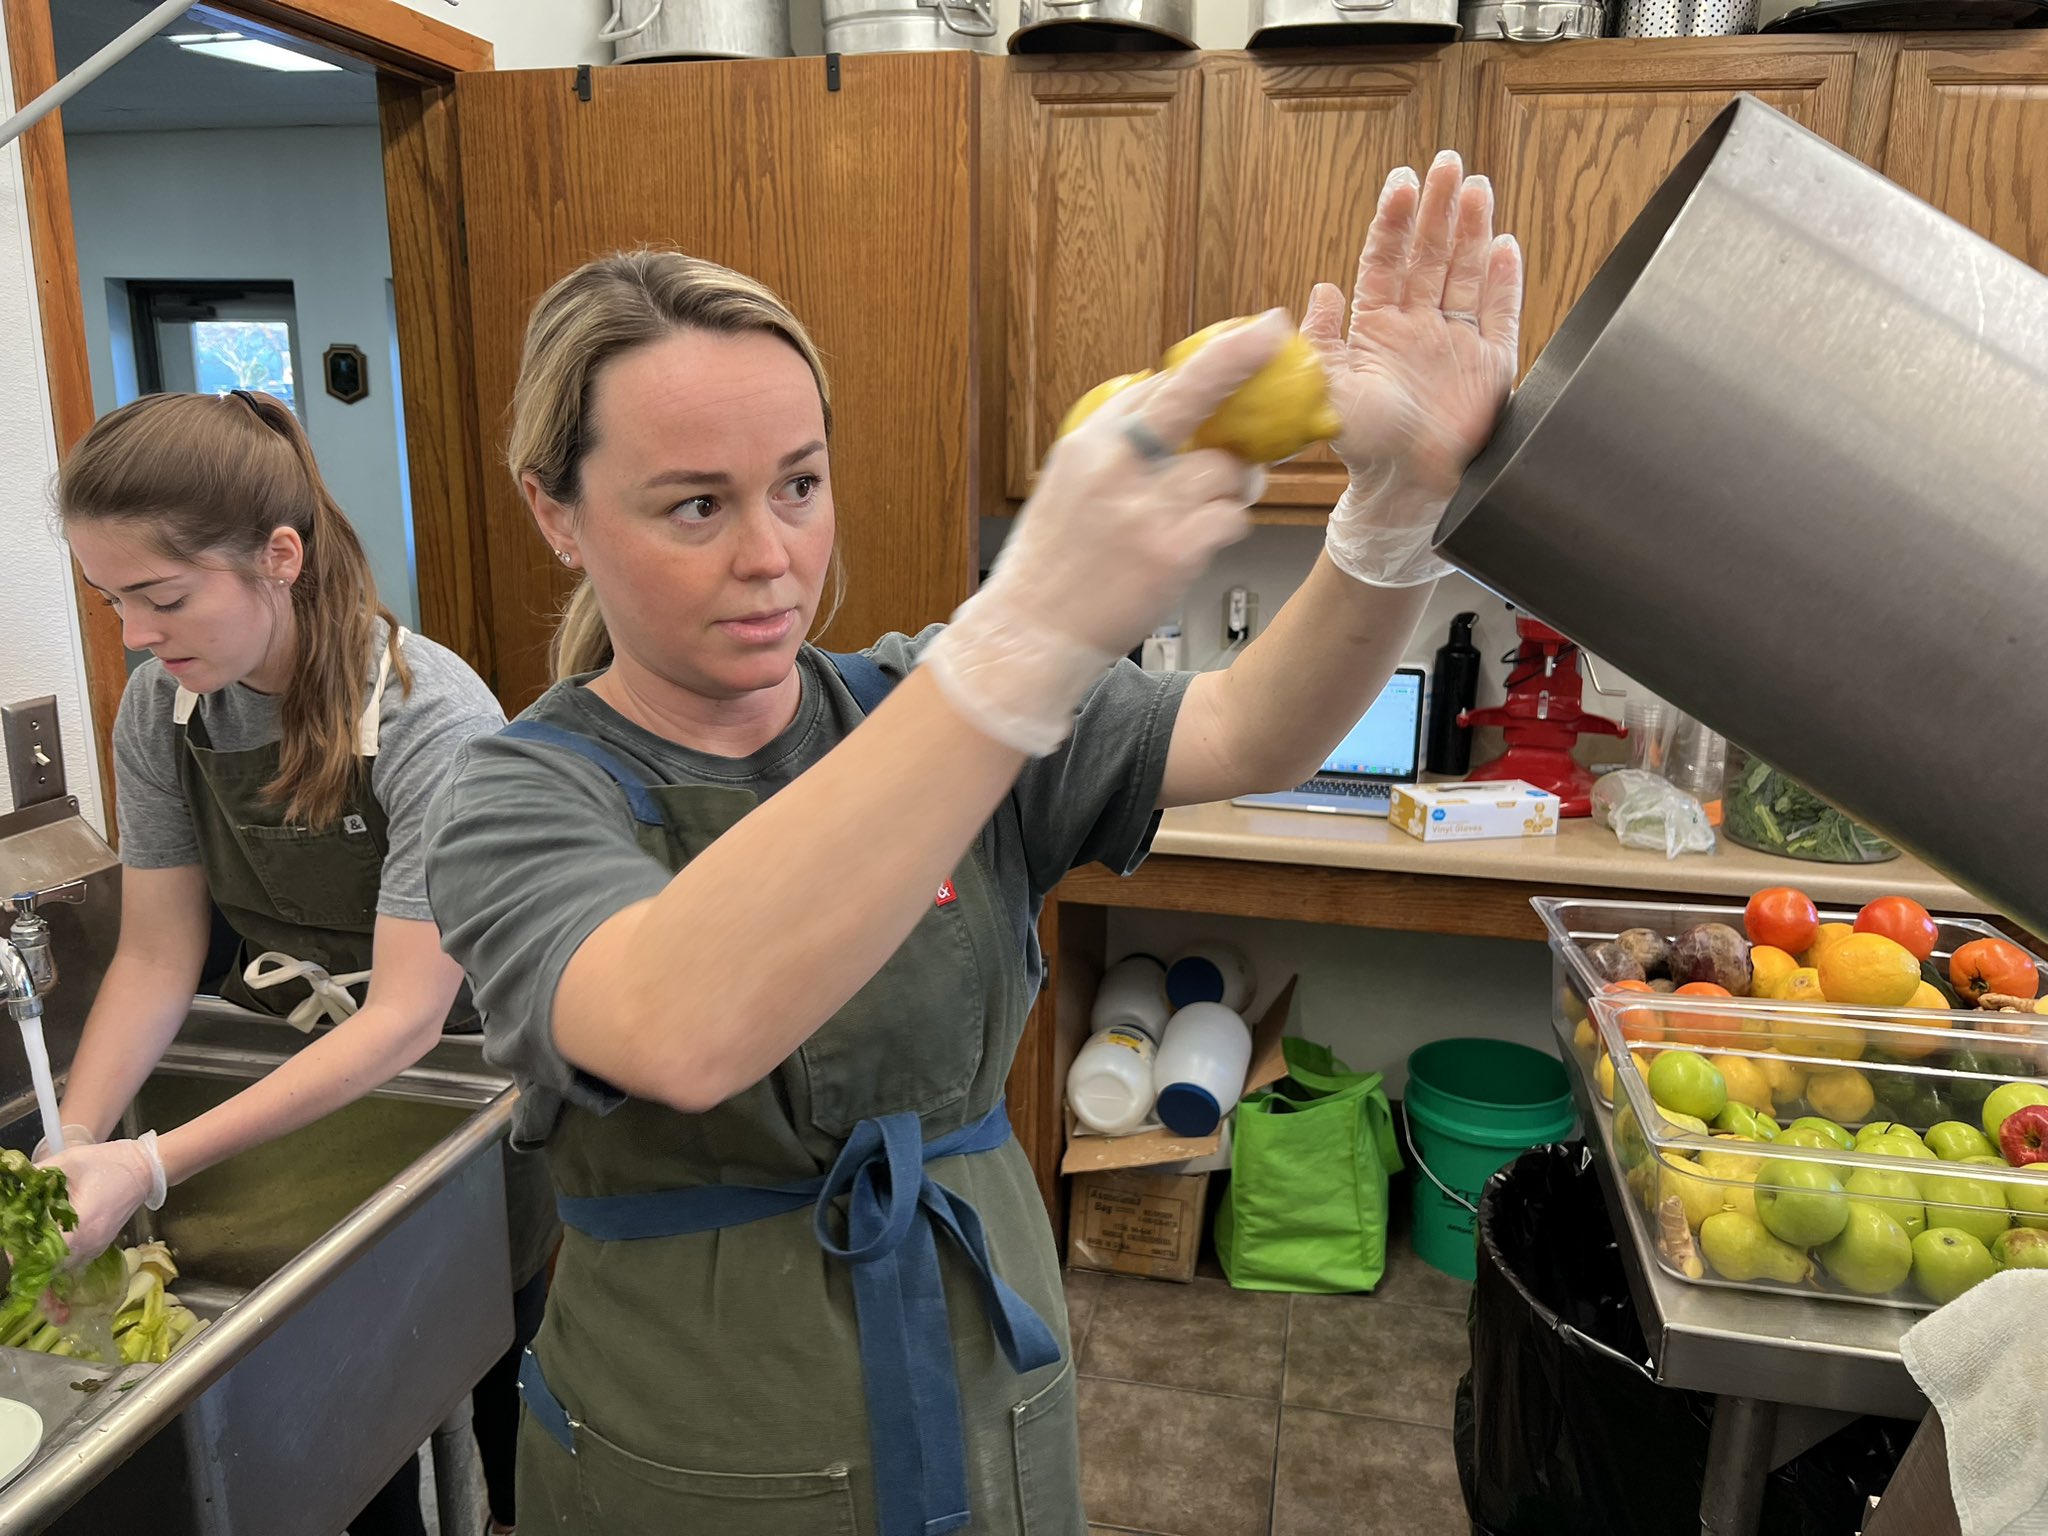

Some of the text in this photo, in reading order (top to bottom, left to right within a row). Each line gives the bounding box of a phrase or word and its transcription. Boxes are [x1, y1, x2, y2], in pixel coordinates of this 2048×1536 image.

[350, 818, 362, 830] &
[1432, 823, 1483, 834] Vinyl Gloves
